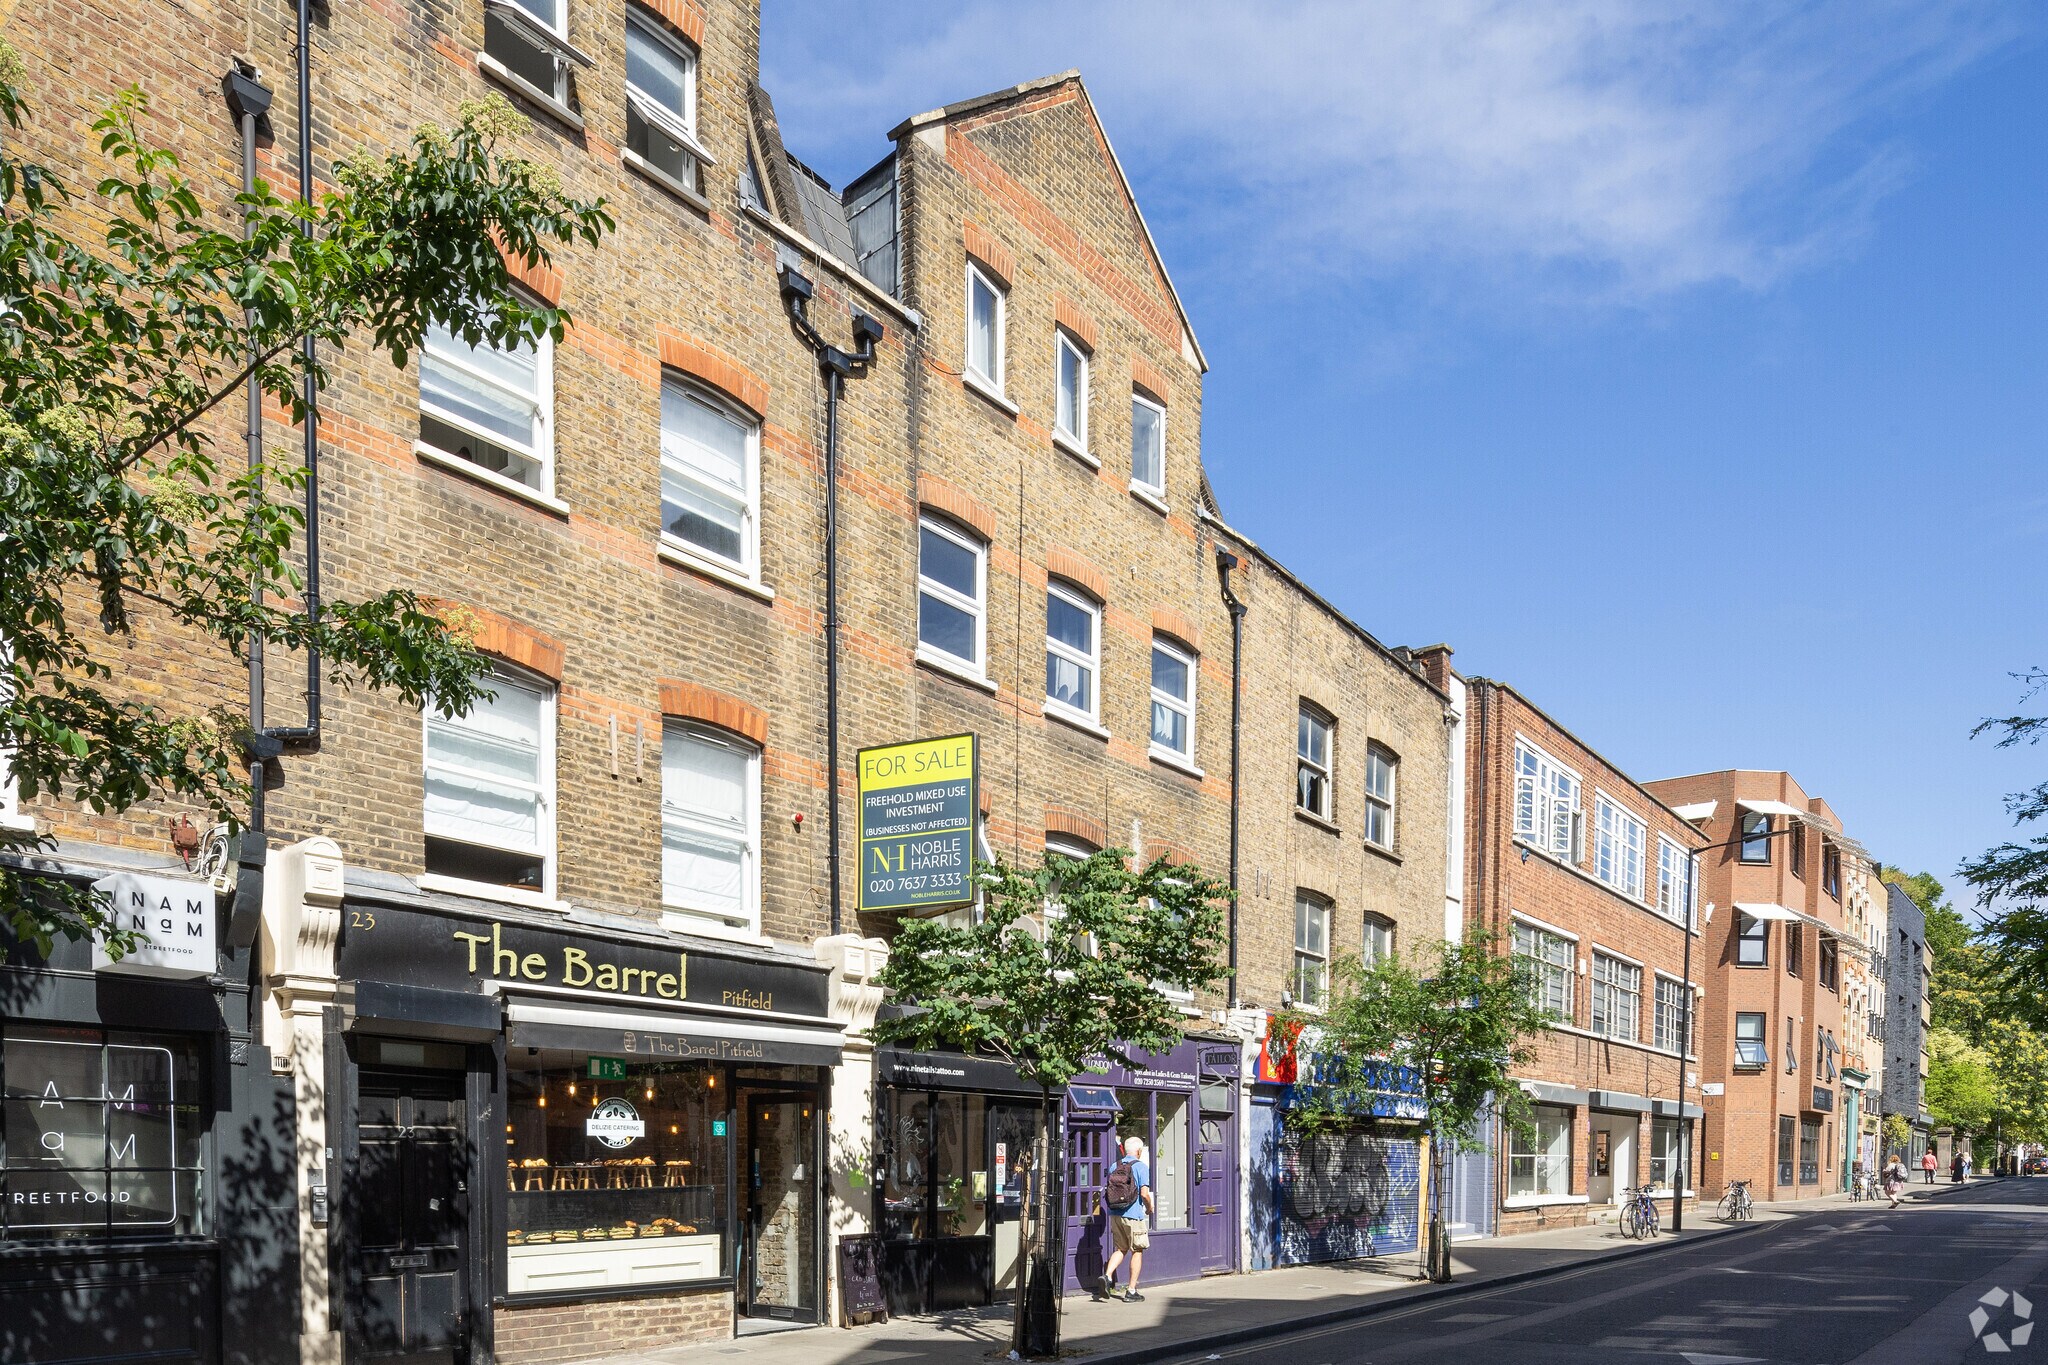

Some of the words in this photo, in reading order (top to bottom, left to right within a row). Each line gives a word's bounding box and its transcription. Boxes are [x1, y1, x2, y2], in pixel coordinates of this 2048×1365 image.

[866, 756, 906, 779] FOR
[915, 747, 966, 772] SALE
[866, 792, 913, 807] FREEHOLD
[916, 789, 945, 801] MIXED
[947, 786, 966, 797] USE
[886, 802, 944, 818] INVESTMENT
[866, 824, 909, 836] (BUSINESSES
[911, 822, 927, 831] NOT
[928, 817, 967, 828] AFFECTED)
[911, 838, 960, 856] NOBLE
[911, 852, 961, 870] HARRIS
[870, 879, 894, 892] 020
[898, 876, 927, 890] 7637
[930, 873, 961, 887] 3333
[911, 890, 960, 898] NOBLEHARRIS.CO.UK
[351, 911, 376, 931] 23
[144, 944, 193, 955] STREETFOOD
[453, 923, 546, 980] The
[562, 947, 687, 1000] Barrel
[722, 990, 772, 1010] Pitfield
[644, 1035, 674, 1053] The
[678, 1037, 718, 1056] Barrel
[721, 1040, 763, 1058] Pitfield
[1206, 1054, 1237, 1064] TAILOR
[399, 1126, 415, 1138] 23
